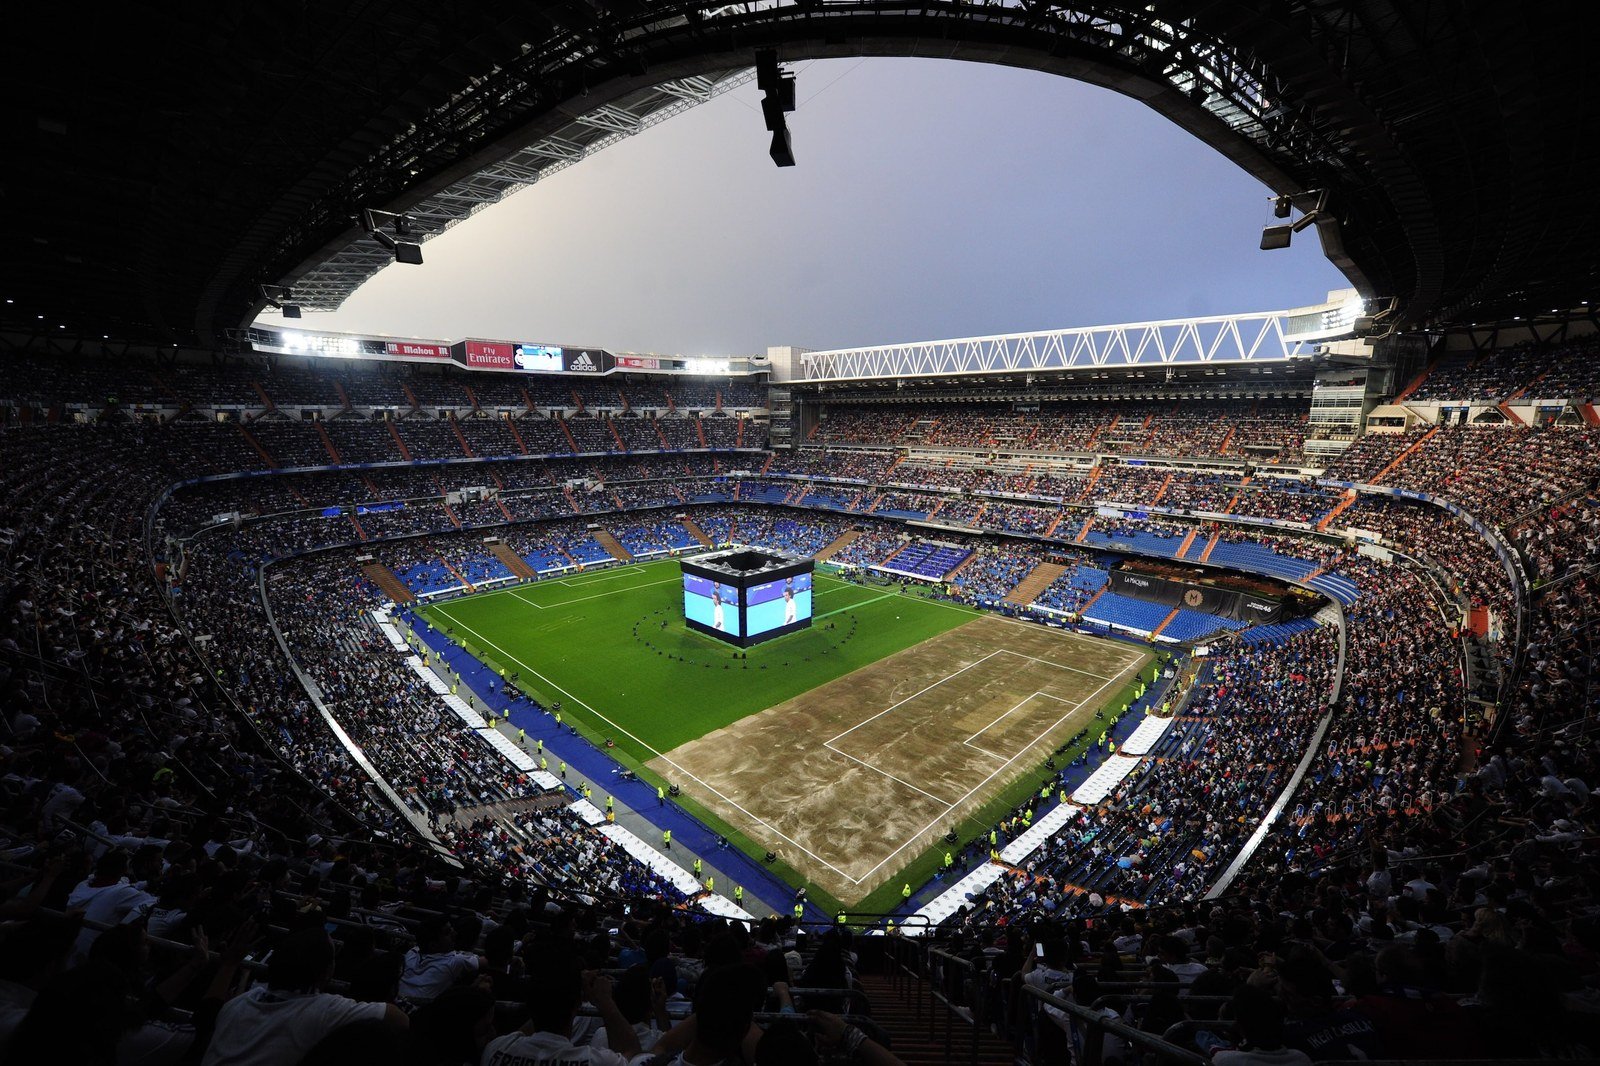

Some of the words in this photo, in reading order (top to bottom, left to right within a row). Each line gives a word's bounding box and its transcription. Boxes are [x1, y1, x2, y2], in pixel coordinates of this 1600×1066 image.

[403, 345, 434, 355] Mahou
[482, 346, 496, 355] Fly
[469, 353, 511, 364] Emirates
[570, 363, 597, 372] adidas
